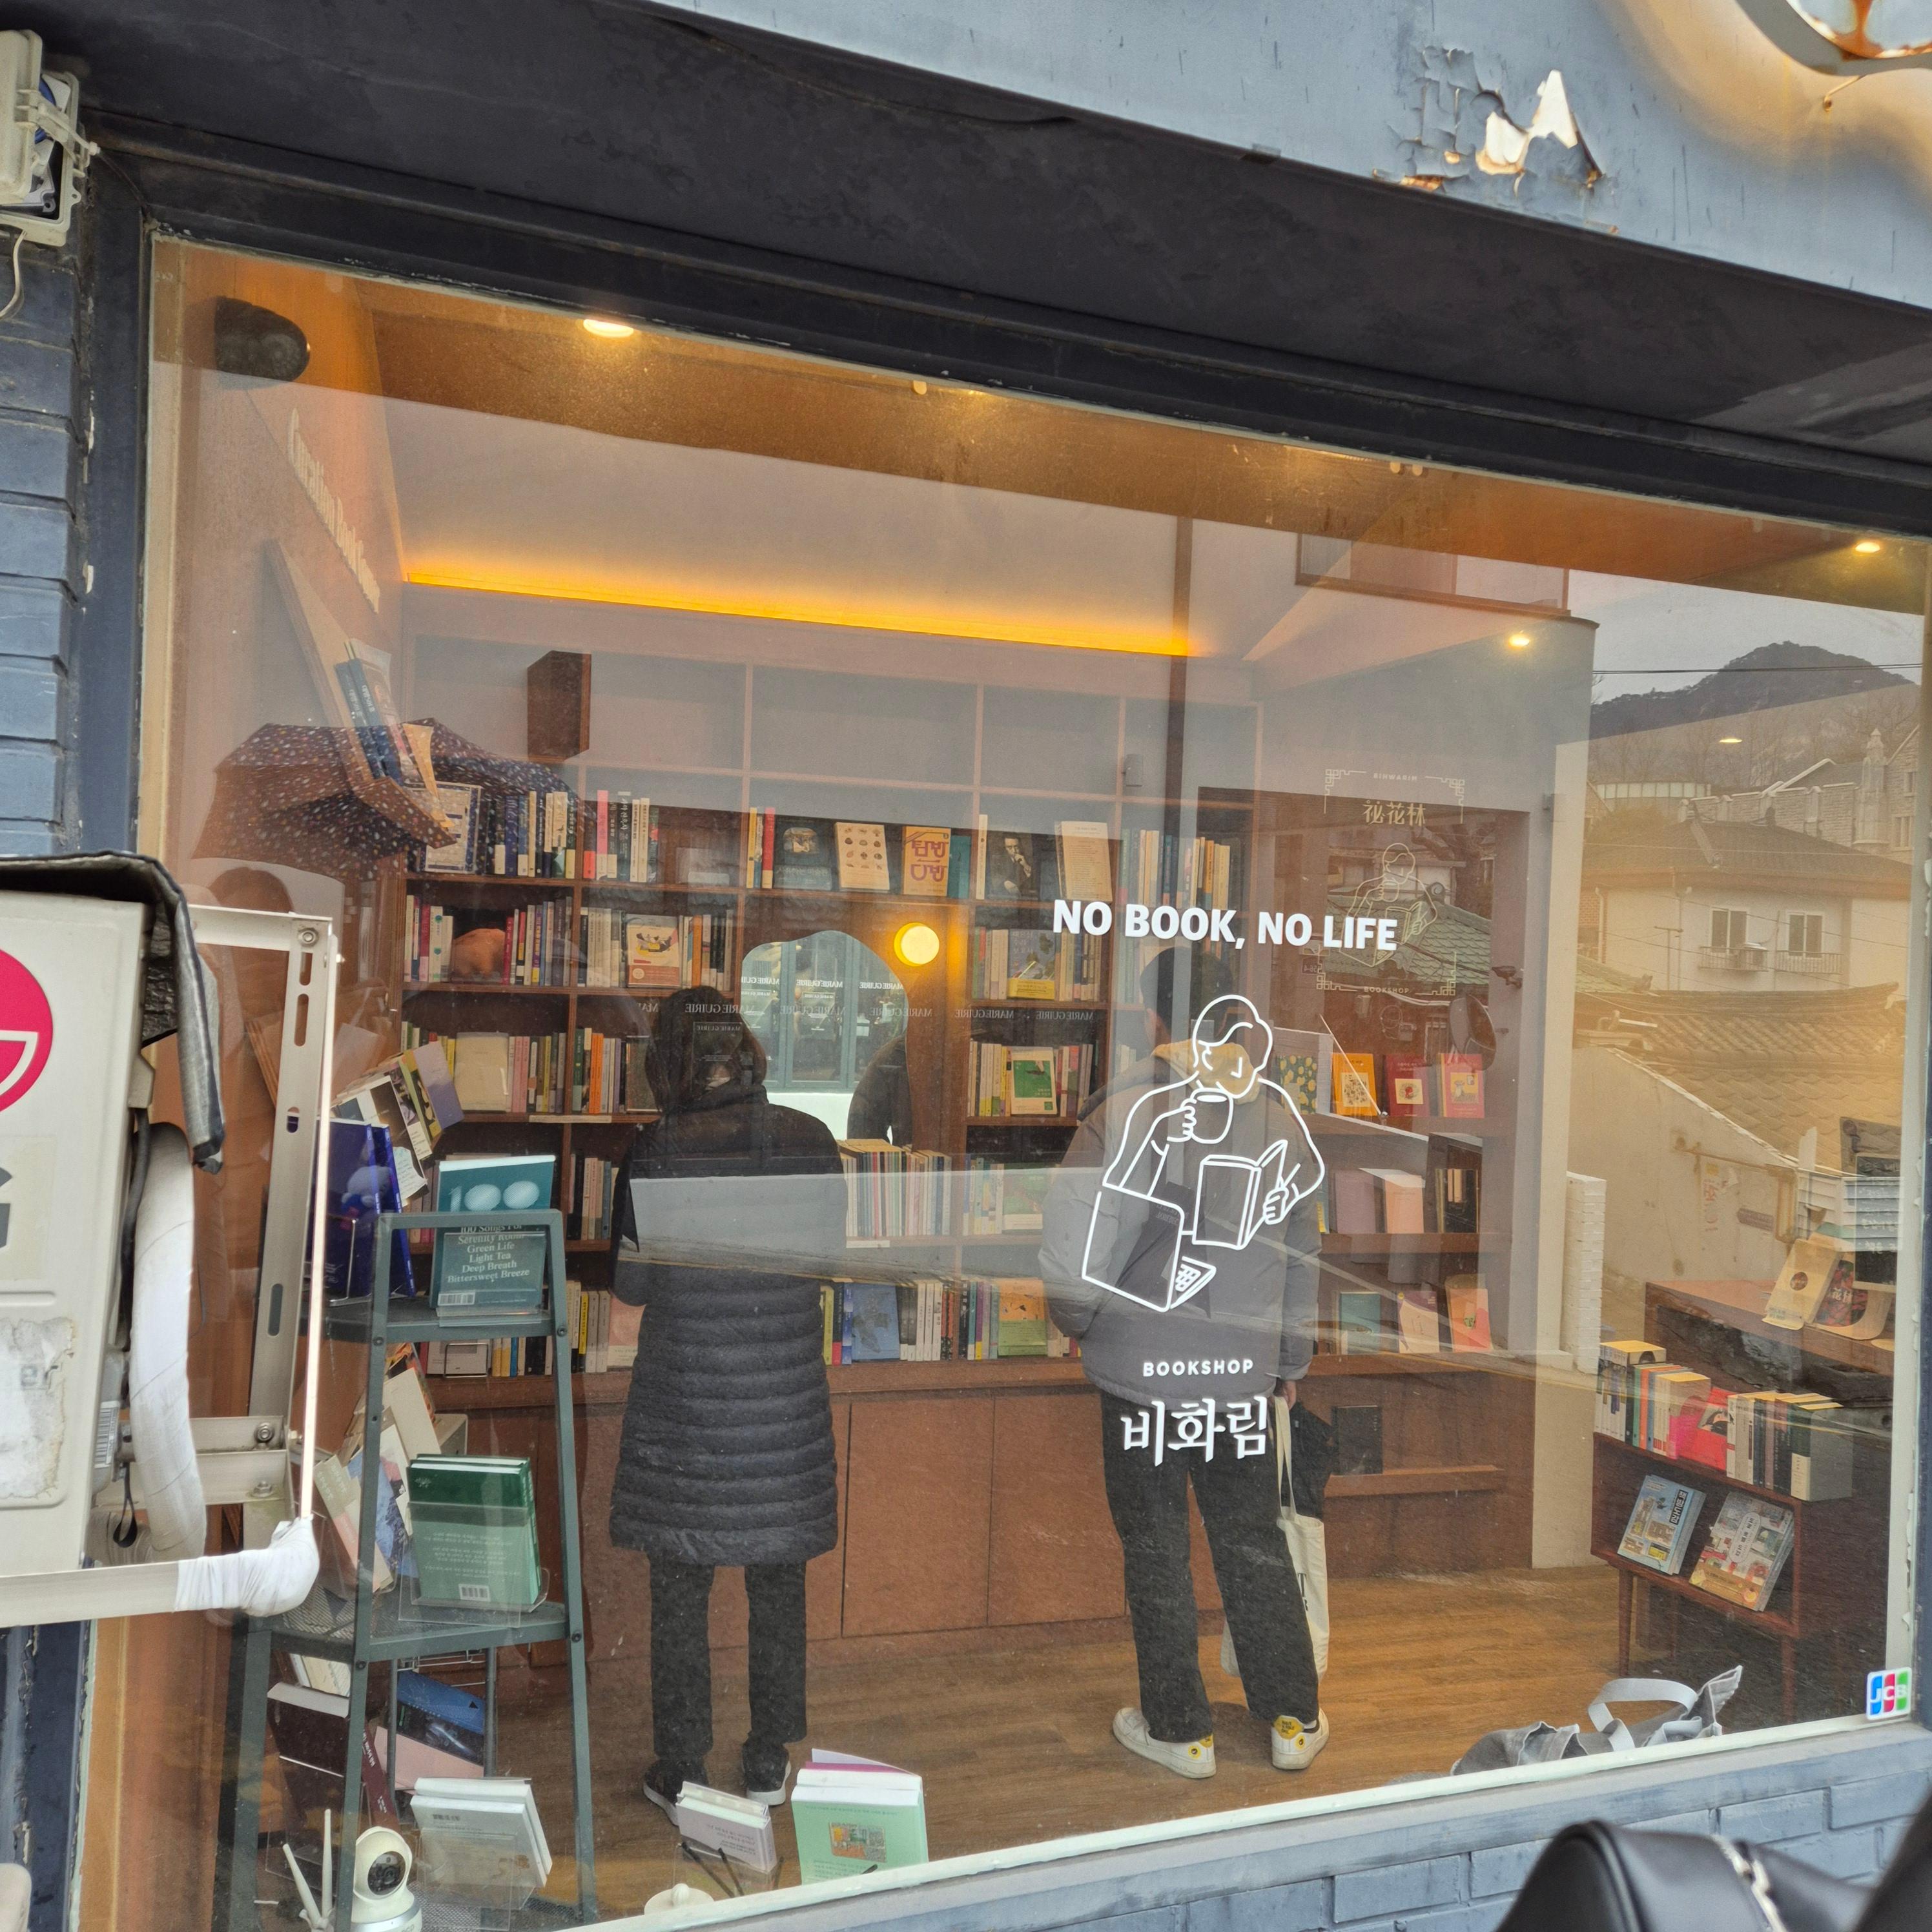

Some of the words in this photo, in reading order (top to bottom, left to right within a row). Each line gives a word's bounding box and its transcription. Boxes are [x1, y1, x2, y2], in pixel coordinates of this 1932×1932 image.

[1053, 899, 1112, 936] NO
[1125, 903, 1245, 949] BOOK,
[1258, 912, 1312, 946] NO
[1324, 916, 1397, 951] LIFE
[458, 1234, 495, 1244] Serenity
[467, 1244, 495, 1253] Green
[497, 1242, 515, 1251] Life
[469, 1253, 493, 1264] Light
[462, 1264, 485, 1275] Deep
[488, 1260, 517, 1271] Breath
[447, 1273, 498, 1283] Bittersweet
[501, 1269, 530, 1279] Breeze
[1142, 1359, 1253, 1377] BOOKSHOP
[1120, 1395, 1268, 1466] 비화림
